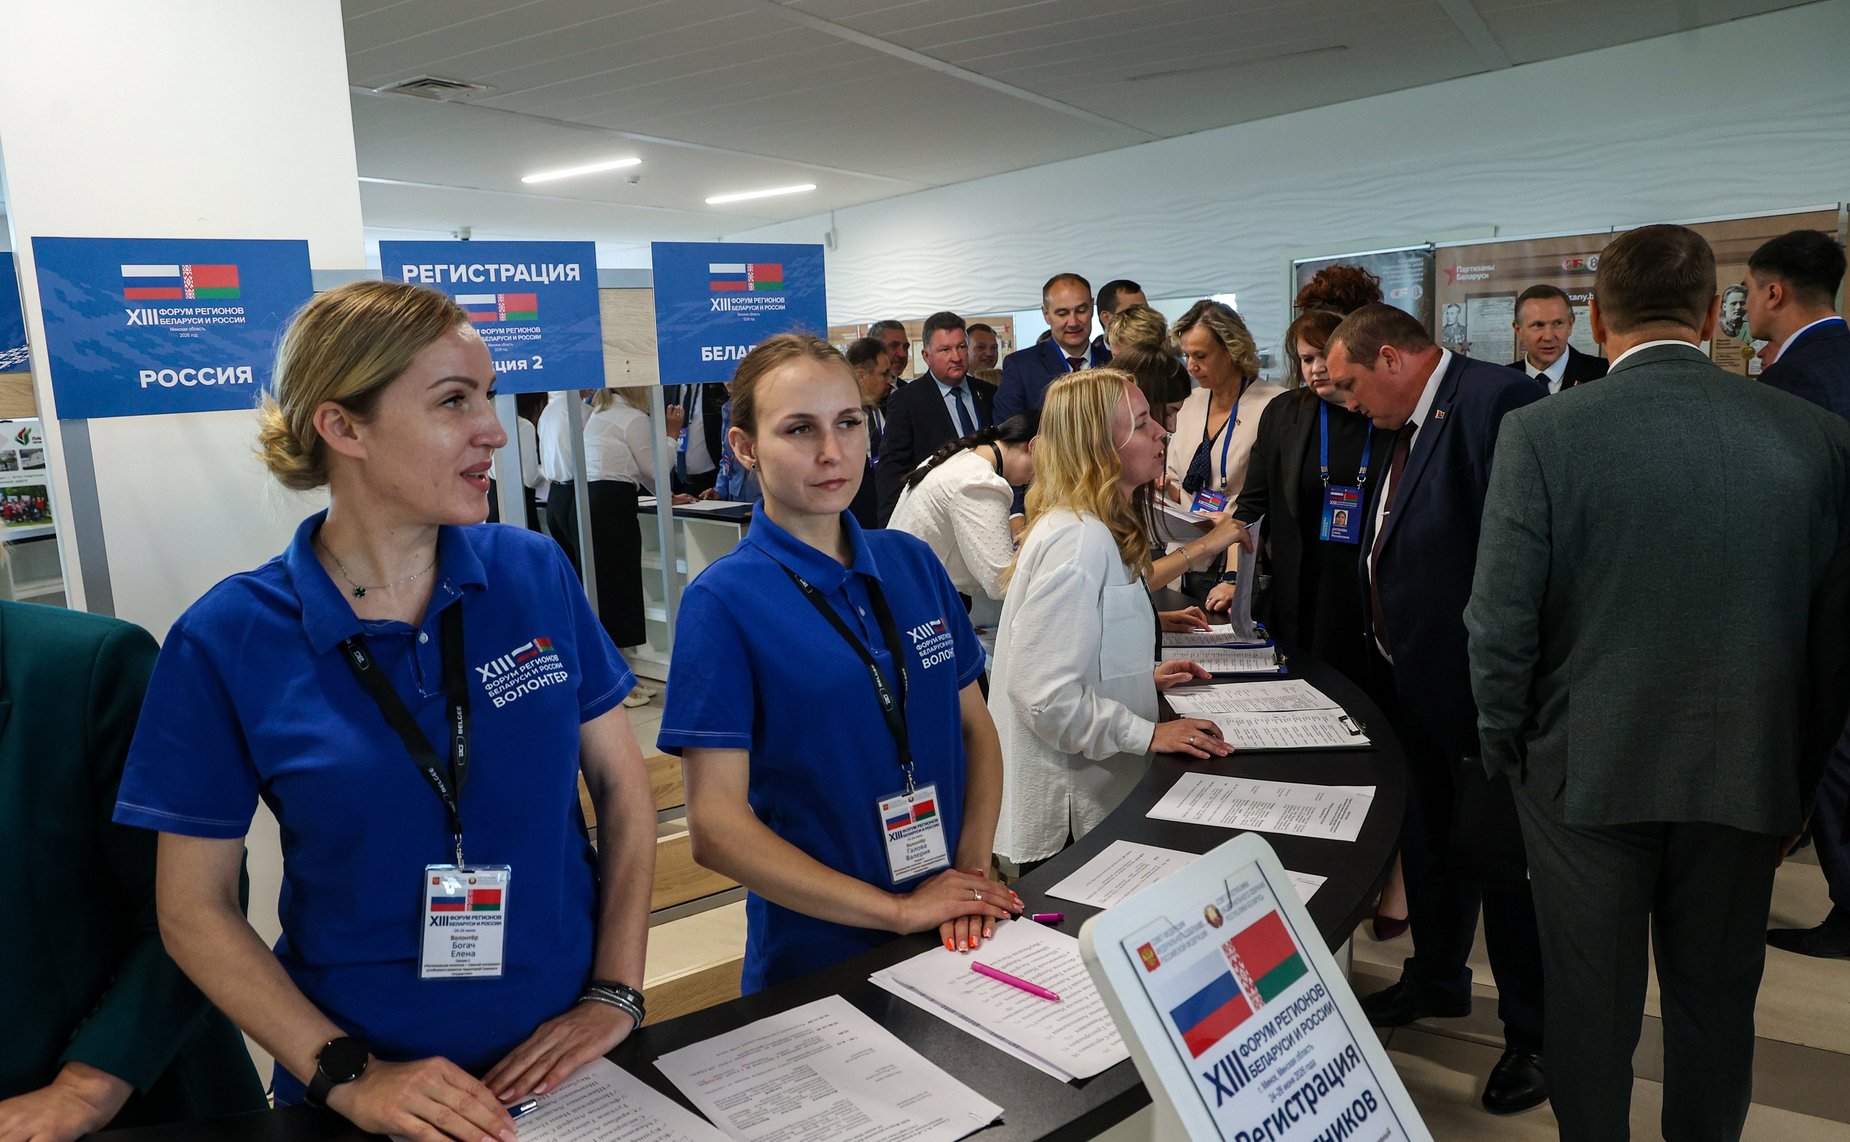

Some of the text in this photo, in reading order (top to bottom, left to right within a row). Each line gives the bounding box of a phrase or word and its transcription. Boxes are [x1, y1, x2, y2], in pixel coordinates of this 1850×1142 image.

[401, 263, 581, 285] РЕГИСТРАЦИЯ
[710, 297, 731, 312] XIII
[753, 296, 786, 304] РЕГИОНОВ
[125, 307, 245, 326] XIII ФОРУМ РЕГИОНОВ
[160, 317, 204, 325] БЕЛАРУСИ
[212, 316, 246, 325] РОССИИ
[480, 327, 505, 335] ФОРУМ
[506, 326, 542, 334] РЕГИОНОВ
[531, 355, 544, 370] 2
[701, 345, 757, 361] БЕЛА
[139, 366, 254, 389] РОССИЯ
[906, 622, 935, 644] XIII
[916, 637, 938, 651] ФОРУМ
[475, 654, 516, 683] XIII
[484, 654, 560, 691] ФОРУМ РЕГИОНОВ
[487, 671, 531, 698] БЕЛАРУСИ
[539, 662, 563, 672] РОССИИ
[492, 670, 569, 709] ВОЛОНТЕР
[888, 830, 904, 842] XIII
[429, 915, 449, 927] XIII
[451, 950, 476, 958] Елена
[1202, 983, 1325, 1108] XIII ФОРУМ РЕГИОНОВ
[1248, 1001, 1335, 1079] БЕЛАРУСИ И РОССИИ
[1234, 1043, 1361, 1142] Регистрация
